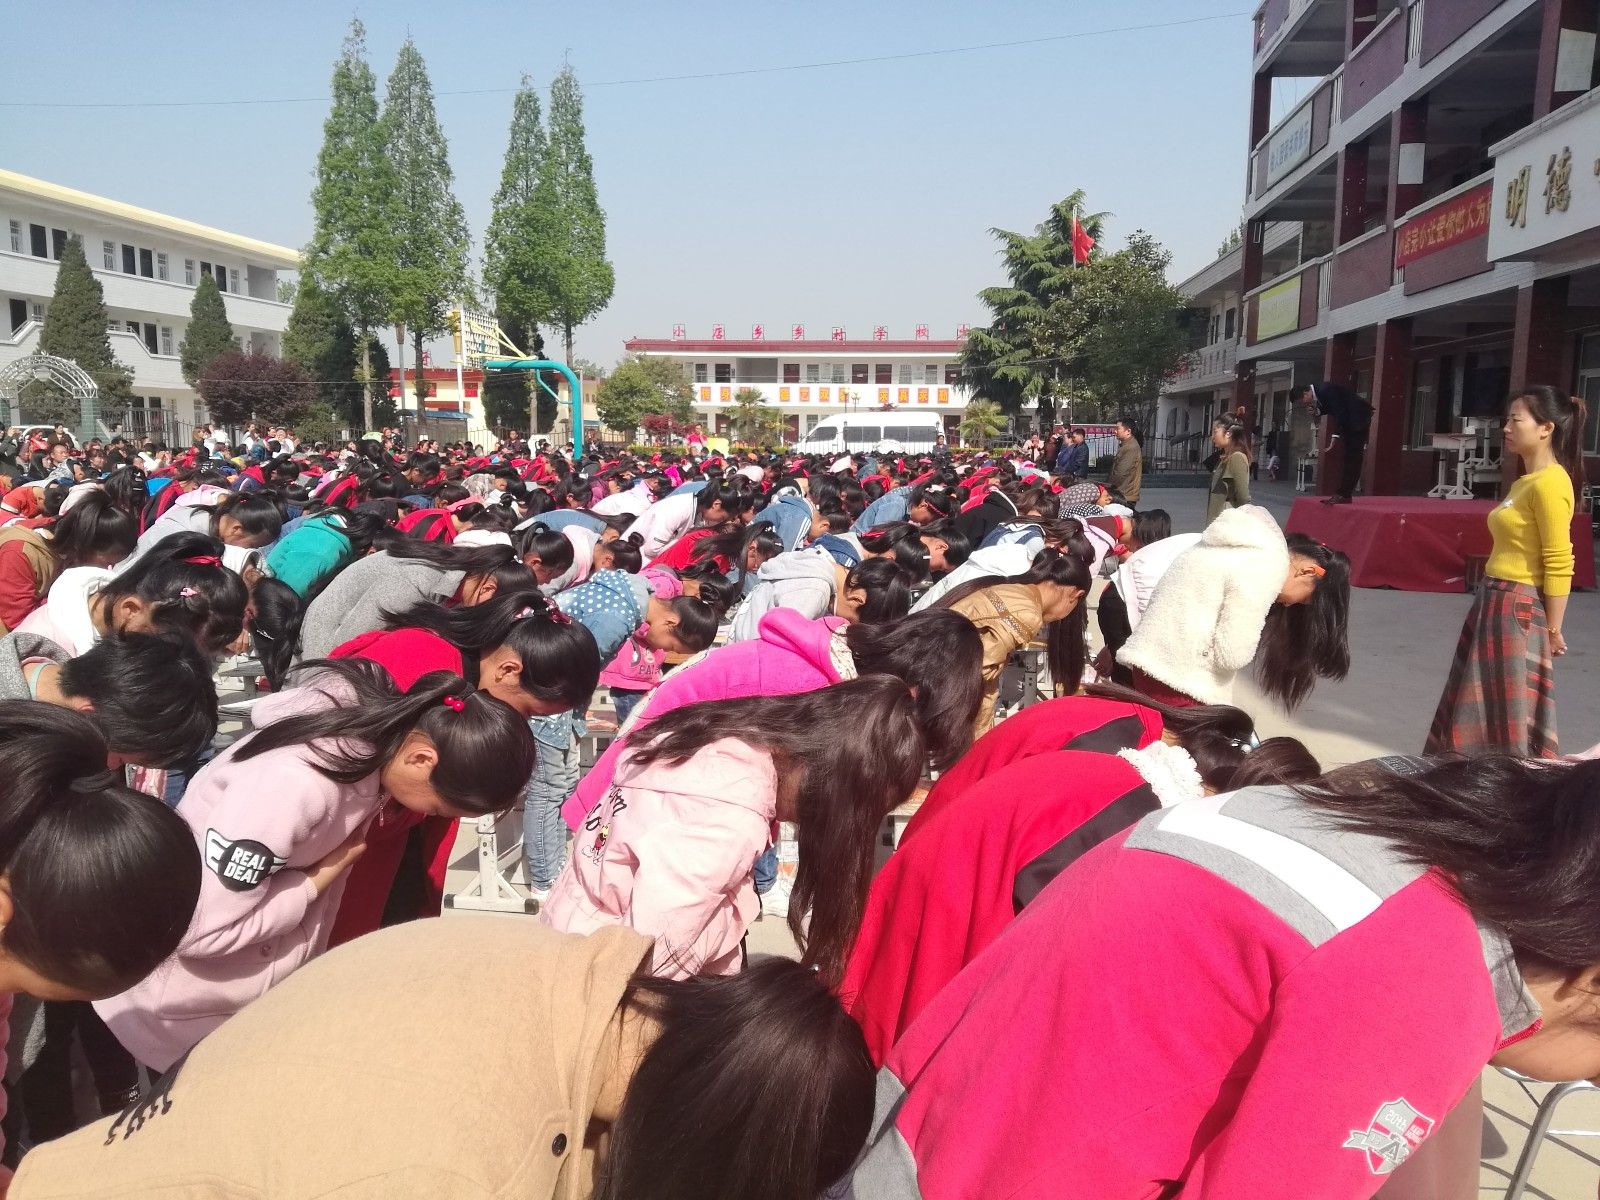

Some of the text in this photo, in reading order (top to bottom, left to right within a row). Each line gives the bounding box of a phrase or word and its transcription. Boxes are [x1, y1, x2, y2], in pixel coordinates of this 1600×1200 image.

[1506, 146, 1600, 228] 明德
[231, 847, 266, 870] REAL
[223, 861, 258, 884] DEAL
[1384, 1109, 1407, 1132] 20th
